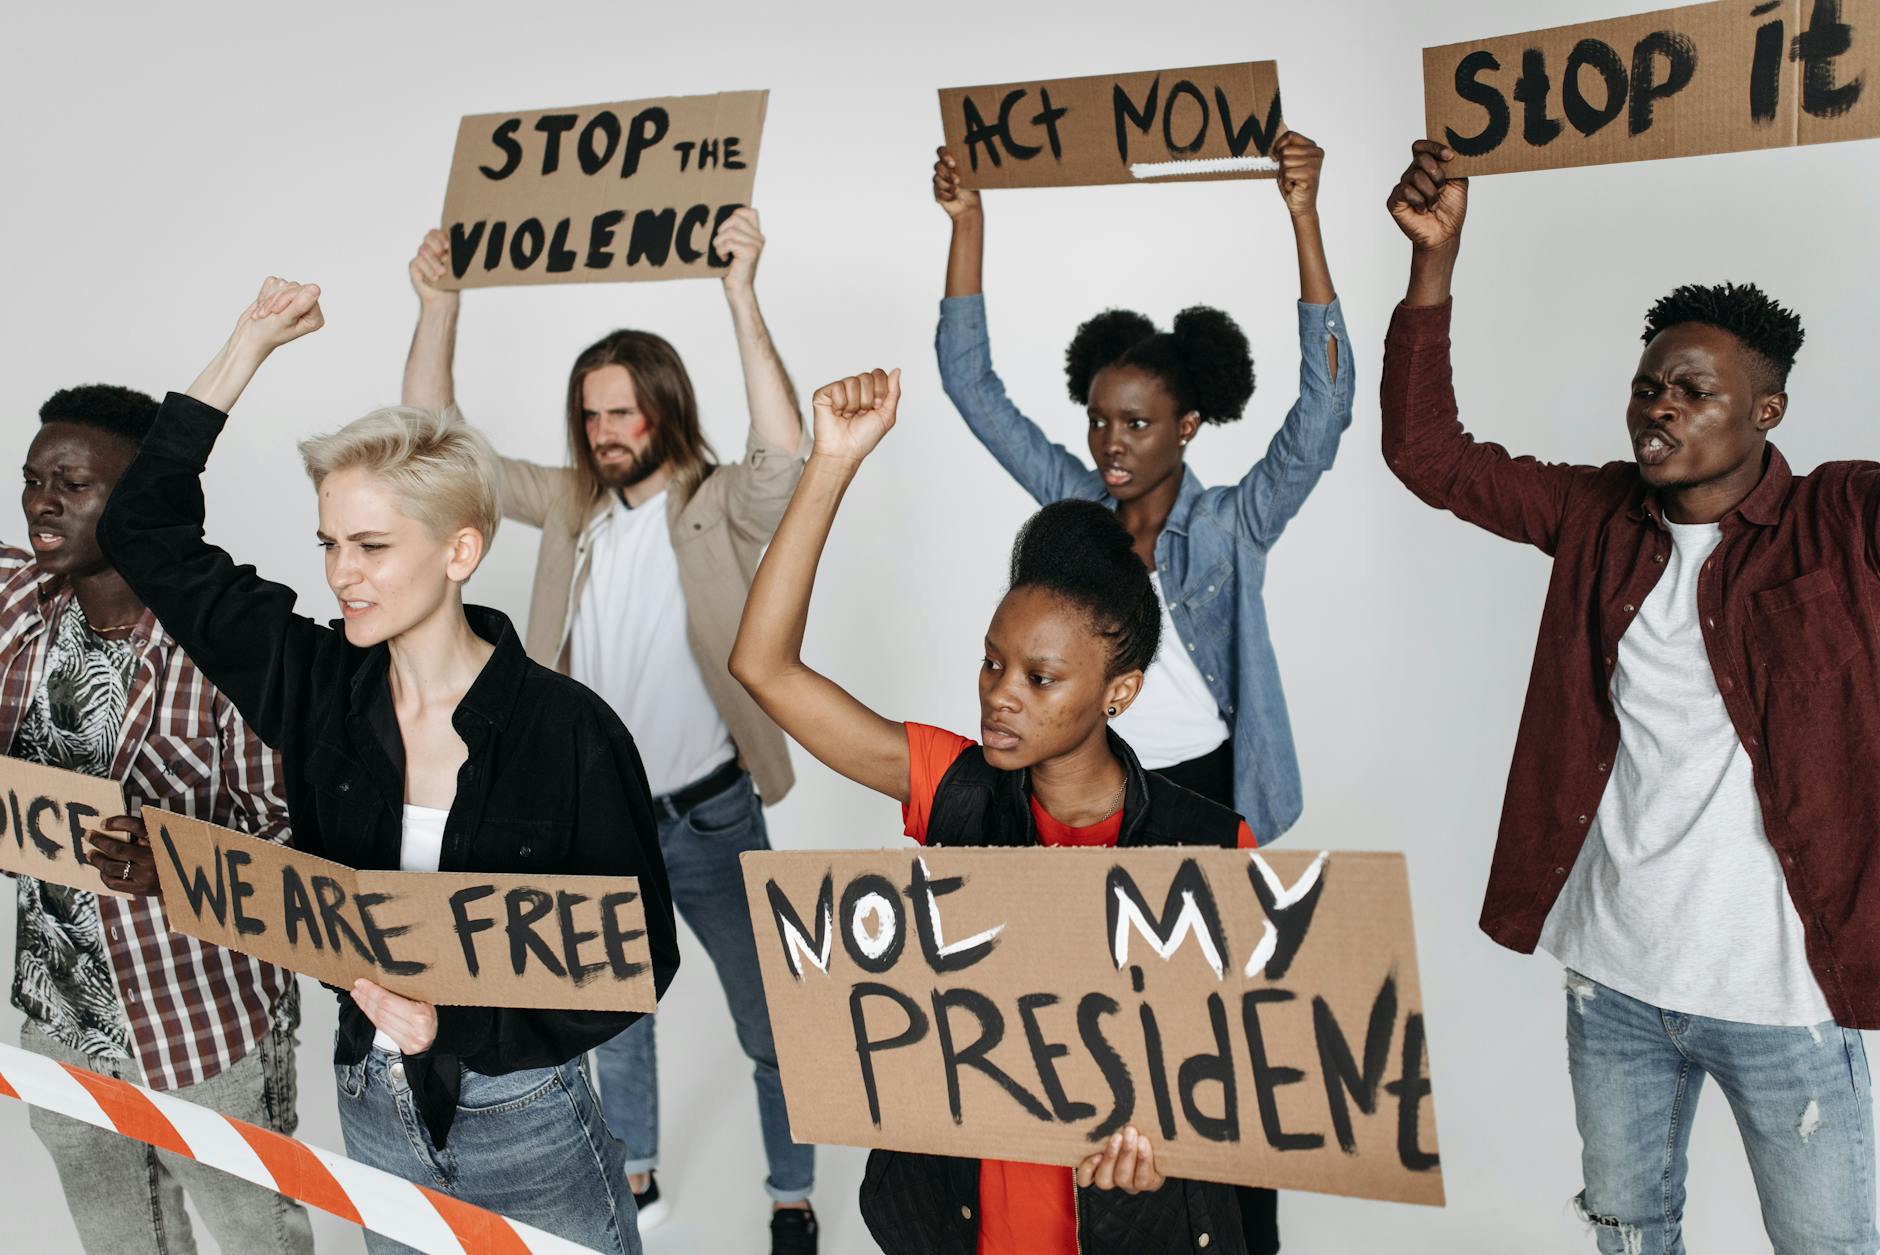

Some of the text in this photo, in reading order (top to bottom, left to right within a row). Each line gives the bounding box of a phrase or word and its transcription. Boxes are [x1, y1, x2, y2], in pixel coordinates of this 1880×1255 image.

[478, 106, 747, 181] STOP THE
[1112, 73, 1282, 165] NOW
[0, 787, 100, 865] ICE
[160, 824, 651, 988] WE ARE FREE
[1106, 851, 1329, 981] MY
